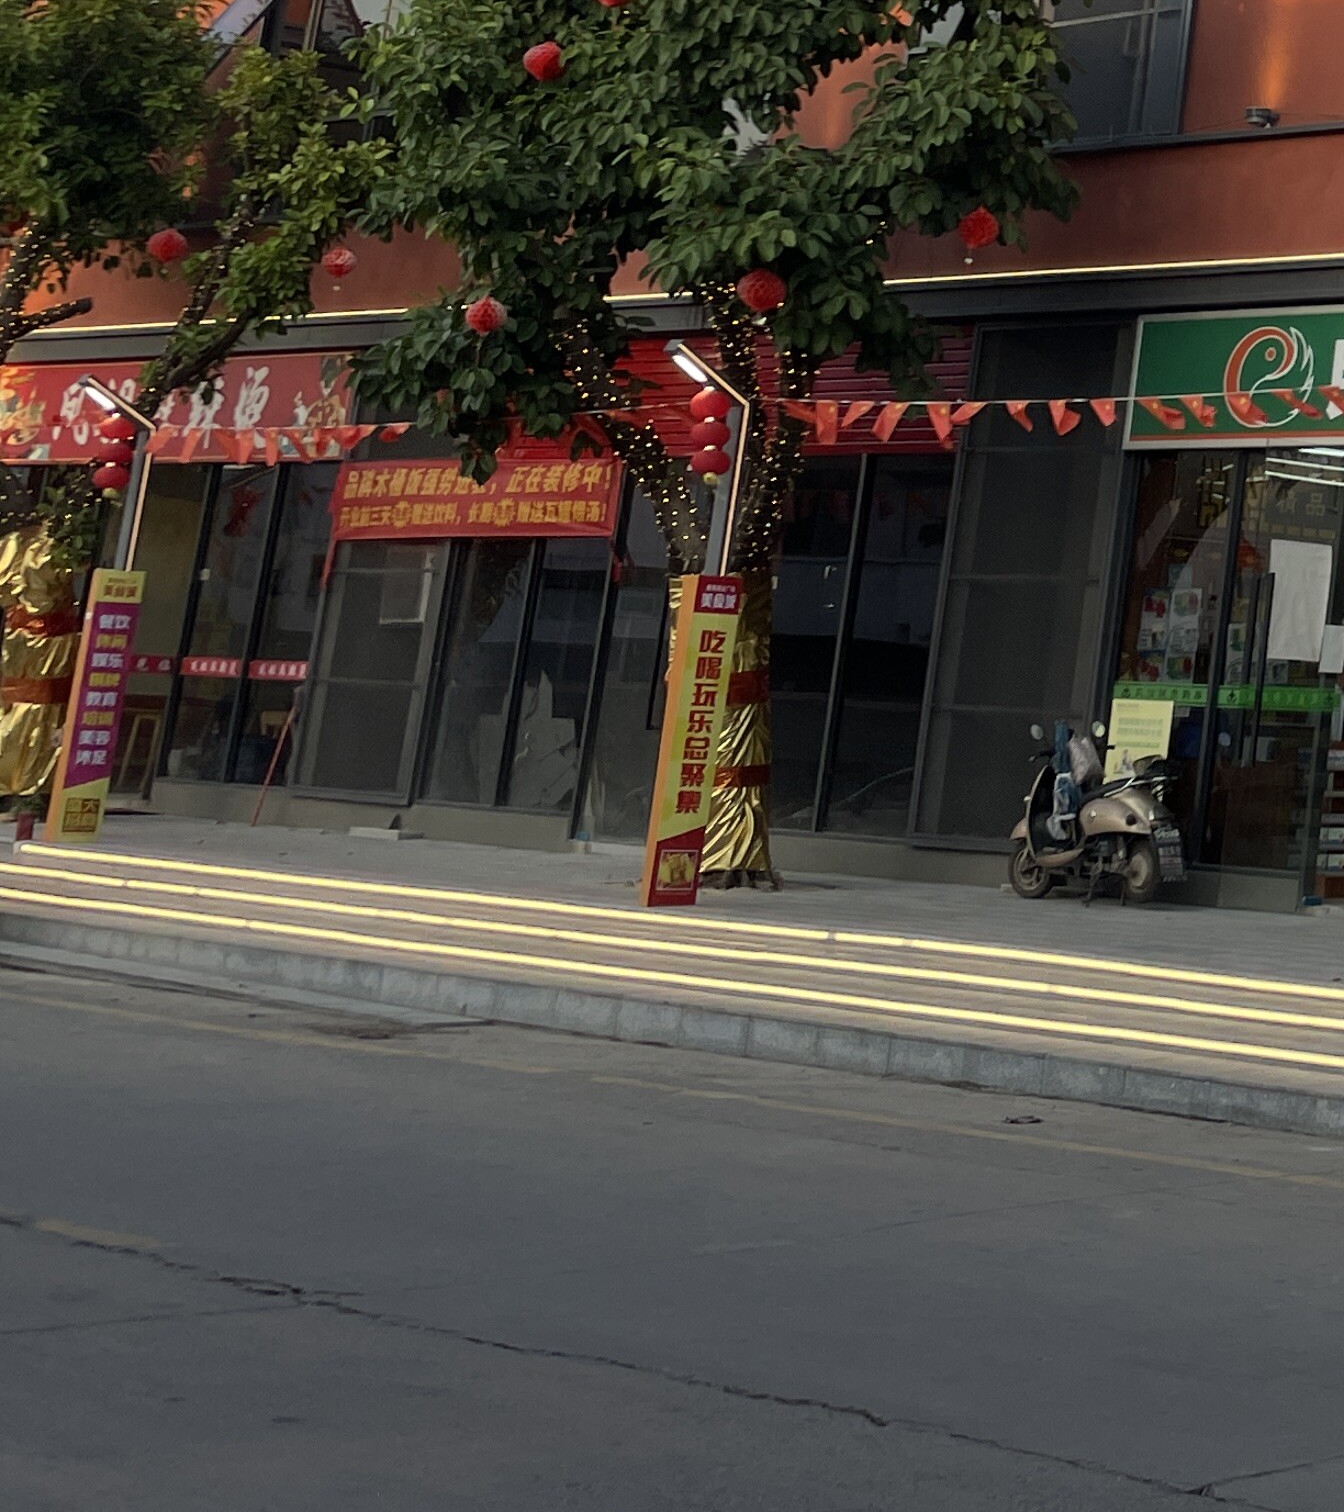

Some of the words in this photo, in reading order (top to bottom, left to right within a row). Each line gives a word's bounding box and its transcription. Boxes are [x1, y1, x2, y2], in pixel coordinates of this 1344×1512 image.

[676, 629, 727, 815] 吃喝玩乐总聚集
